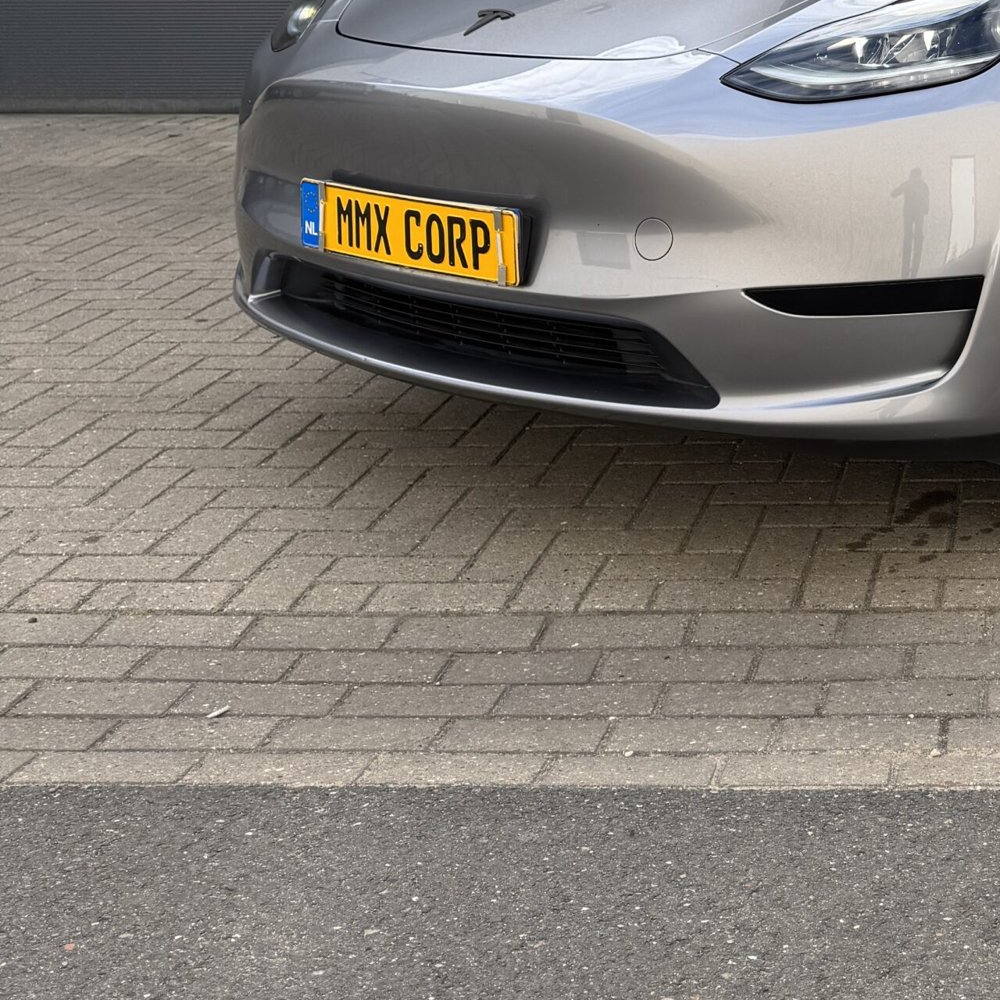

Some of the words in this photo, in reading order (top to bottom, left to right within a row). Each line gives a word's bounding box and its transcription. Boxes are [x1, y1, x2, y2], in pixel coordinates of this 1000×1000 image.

[304, 220, 318, 236] NL
[336, 196, 391, 255] MMX
[404, 209, 490, 270] CORP
